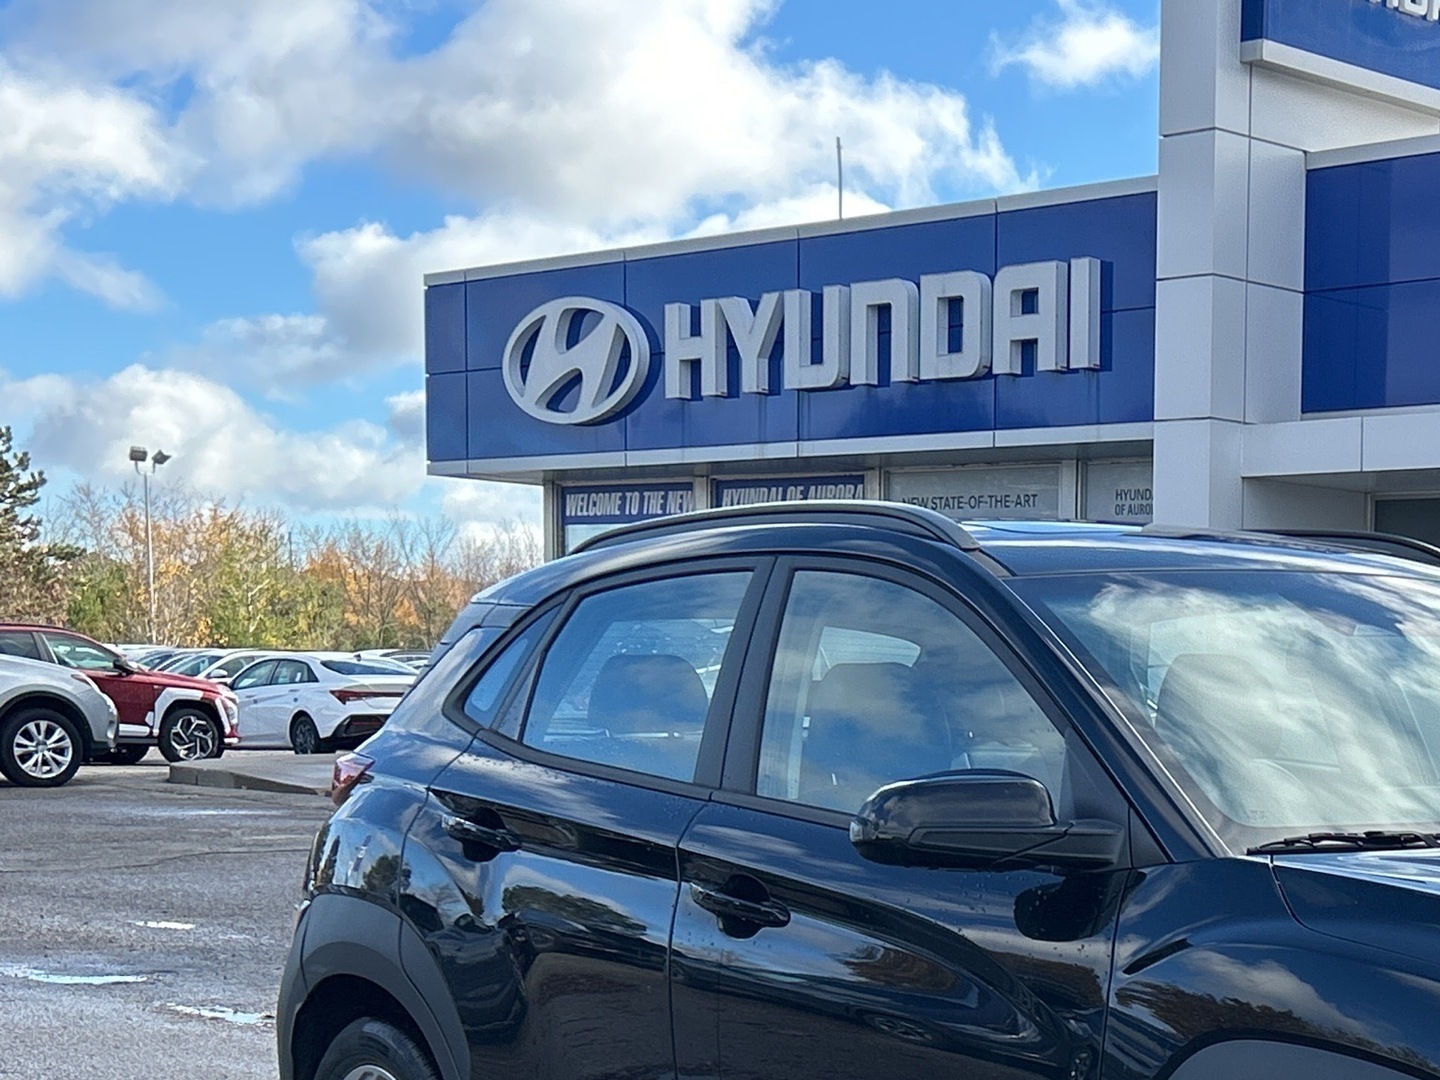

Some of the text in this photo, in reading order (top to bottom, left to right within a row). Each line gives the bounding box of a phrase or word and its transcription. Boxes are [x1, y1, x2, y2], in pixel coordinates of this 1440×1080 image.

[664, 257, 1101, 400] HYUNDAI
[565, 489, 695, 517] WELCOME TO THE NEW
[722, 486, 783, 507] HYUNDAI
[807, 484, 865, 501] AURORA
[930, 493, 1038, 511] STATE-OF-THE-ART
[1115, 488, 1153, 501] HYUND
[1114, 503, 1153, 516] OF AURO
